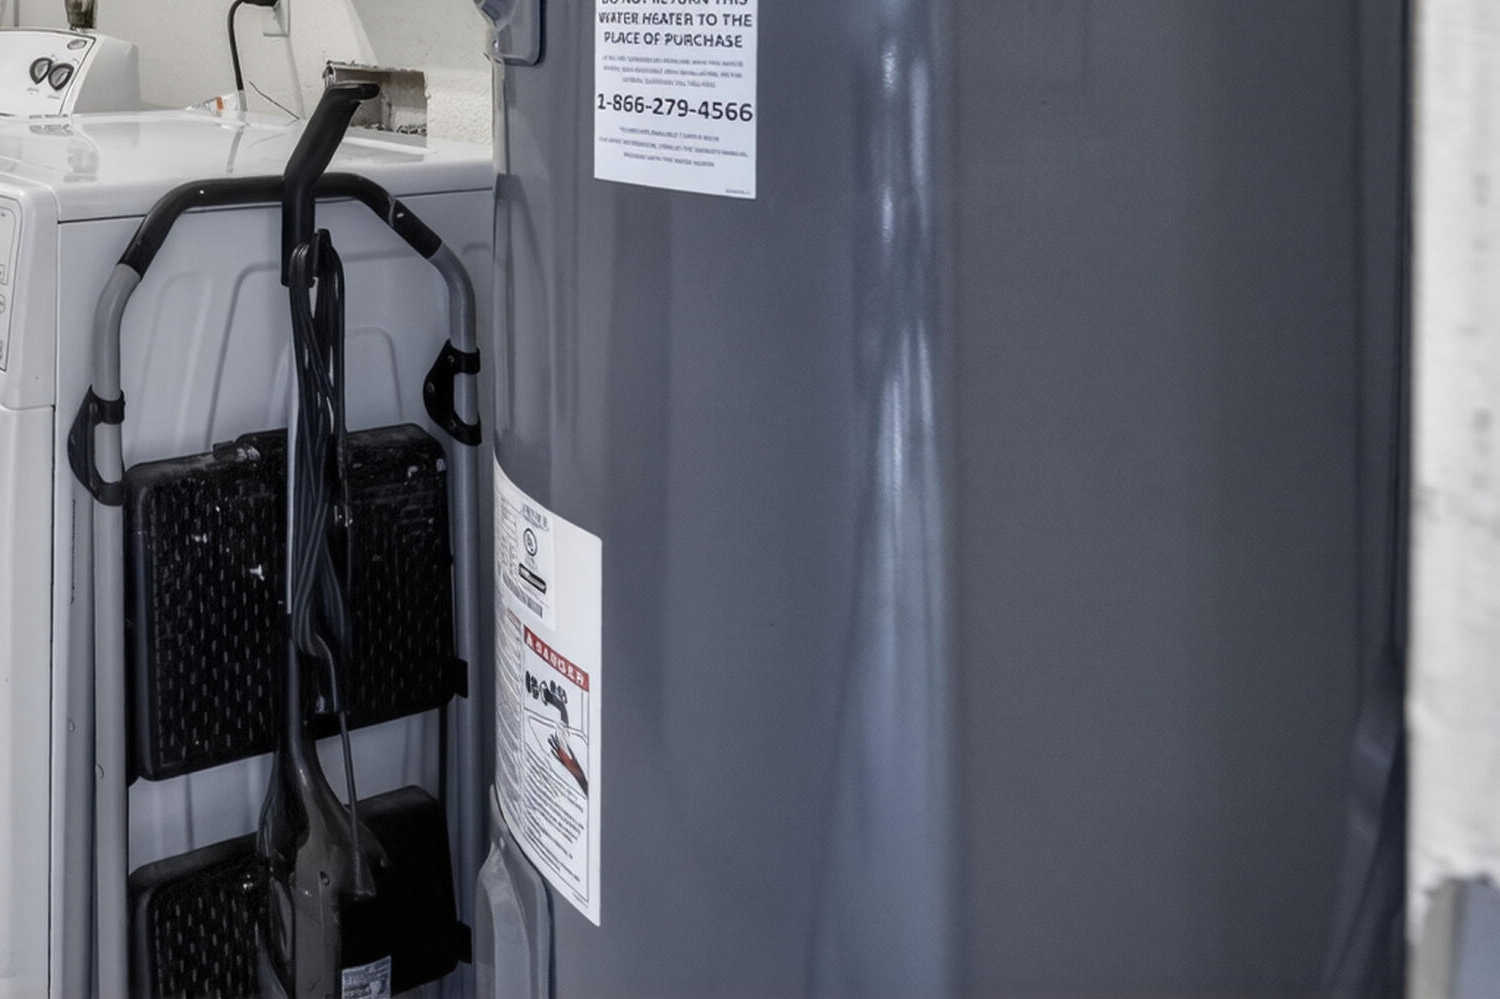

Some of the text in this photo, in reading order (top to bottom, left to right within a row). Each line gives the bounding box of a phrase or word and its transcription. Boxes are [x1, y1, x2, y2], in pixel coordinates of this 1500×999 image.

[598, 11, 753, 28] WATER HEATER TO THE
[603, 31, 743, 49] PLACE OF PURCHASE
[597, 93, 753, 122] 1-866-279-4566
